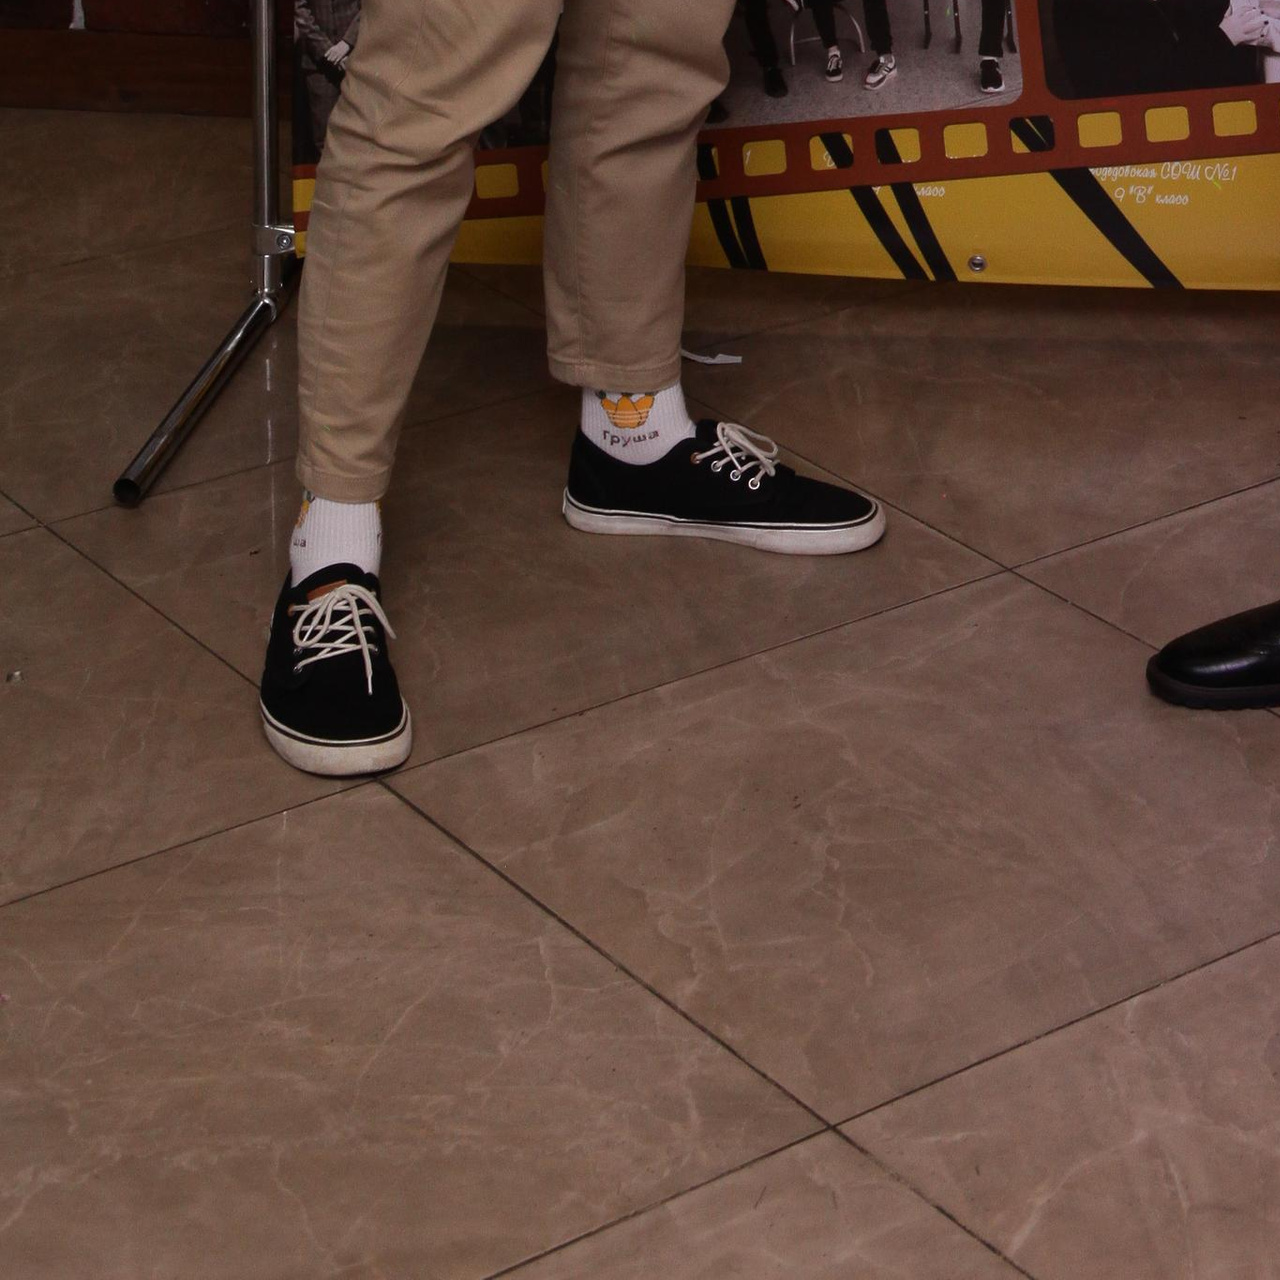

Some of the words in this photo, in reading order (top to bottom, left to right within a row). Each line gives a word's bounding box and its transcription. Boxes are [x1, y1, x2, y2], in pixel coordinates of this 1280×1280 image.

[1160, 162, 1200, 180] СОШ
[1205, 164, 1237, 182] №1
[1115, 187, 1124, 202] 9
